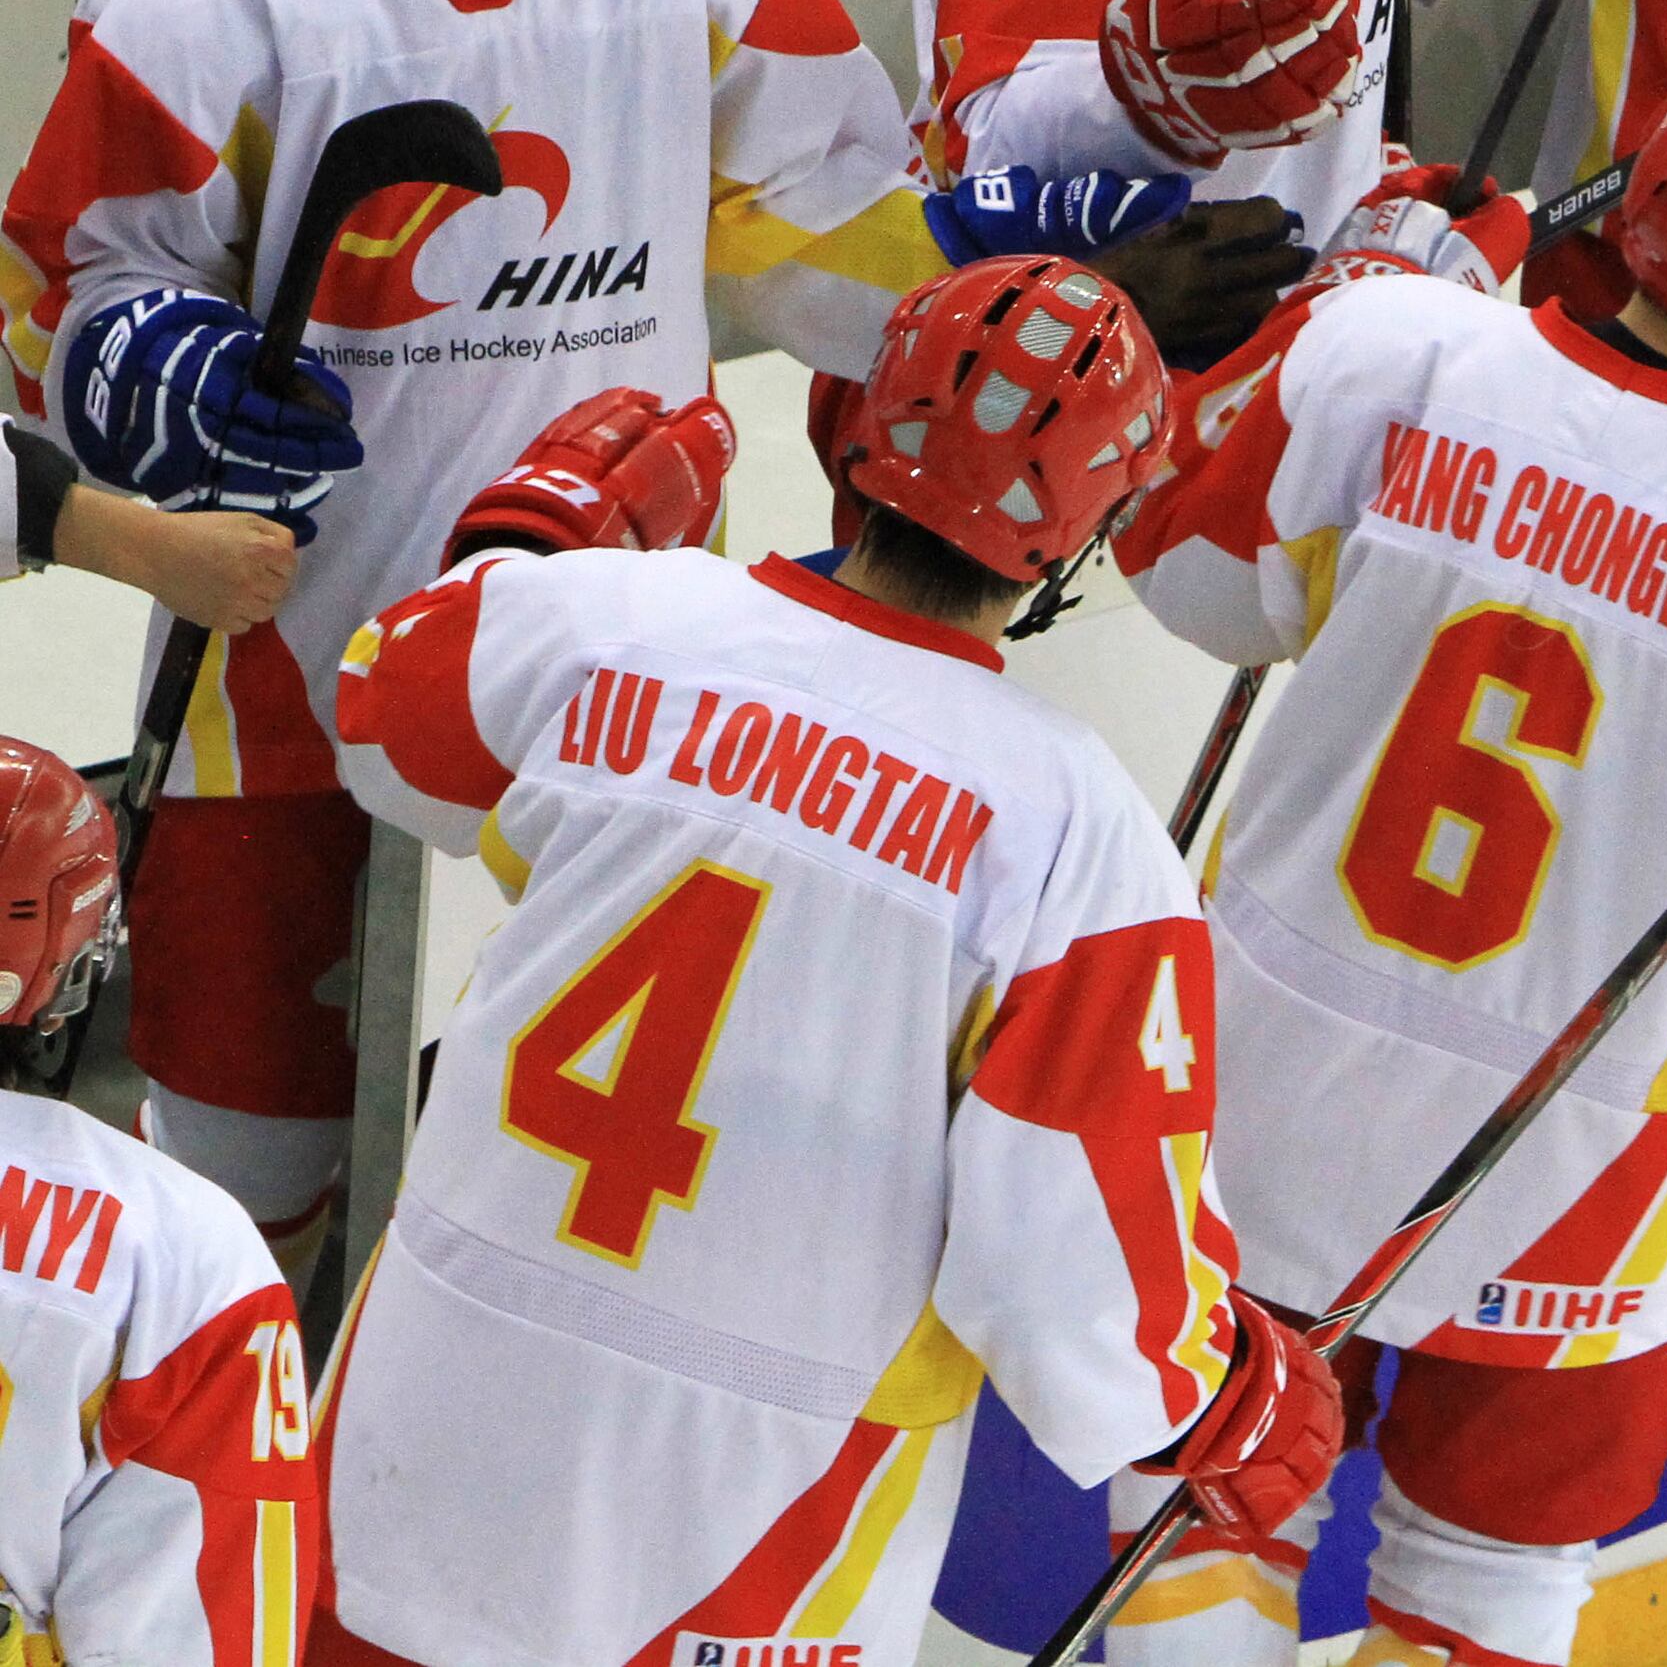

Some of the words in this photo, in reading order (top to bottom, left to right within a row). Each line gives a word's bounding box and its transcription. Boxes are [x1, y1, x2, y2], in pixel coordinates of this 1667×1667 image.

[312, 345, 395, 369] hinese
[403, 342, 441, 365] Ice
[451, 334, 547, 362] Hockey
[551, 313, 658, 355] Association
[559, 667, 666, 775] LIU
[667, 689, 995, 896] LONGTAN
[1335, 599, 1605, 975] 6
[501, 856, 773, 1271] 4
[1137, 955, 1197, 1094] 4
[1515, 1288, 1645, 1329] IIHF
[243, 1320, 310, 1462] 19
